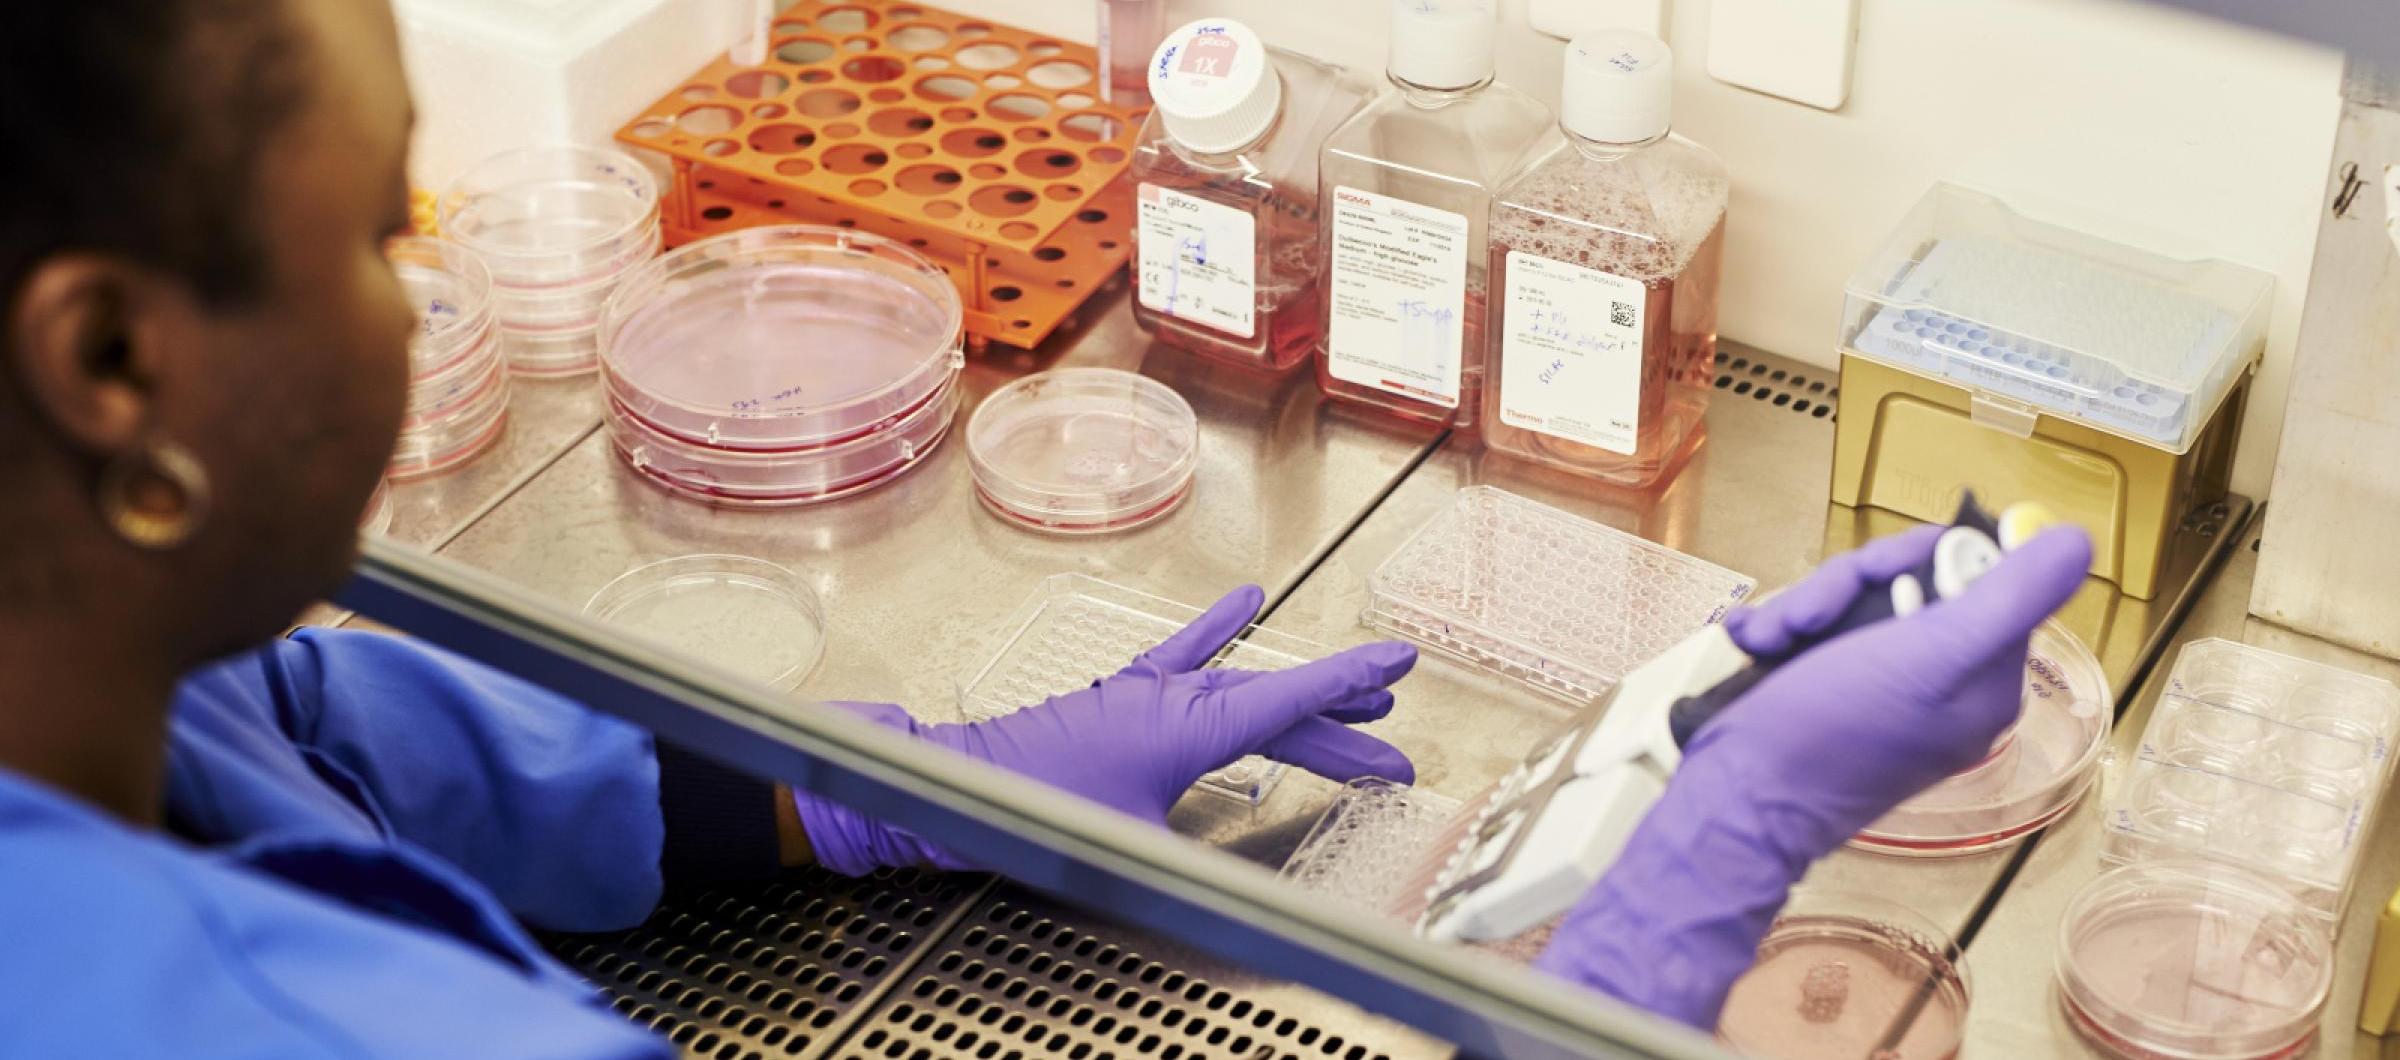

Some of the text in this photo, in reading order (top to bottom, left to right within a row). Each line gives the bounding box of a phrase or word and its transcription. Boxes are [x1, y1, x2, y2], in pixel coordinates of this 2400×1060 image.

[1194, 57, 1219, 75] 1X
[1166, 195, 1200, 213] gibco
[1506, 409, 1543, 424] Thermo
